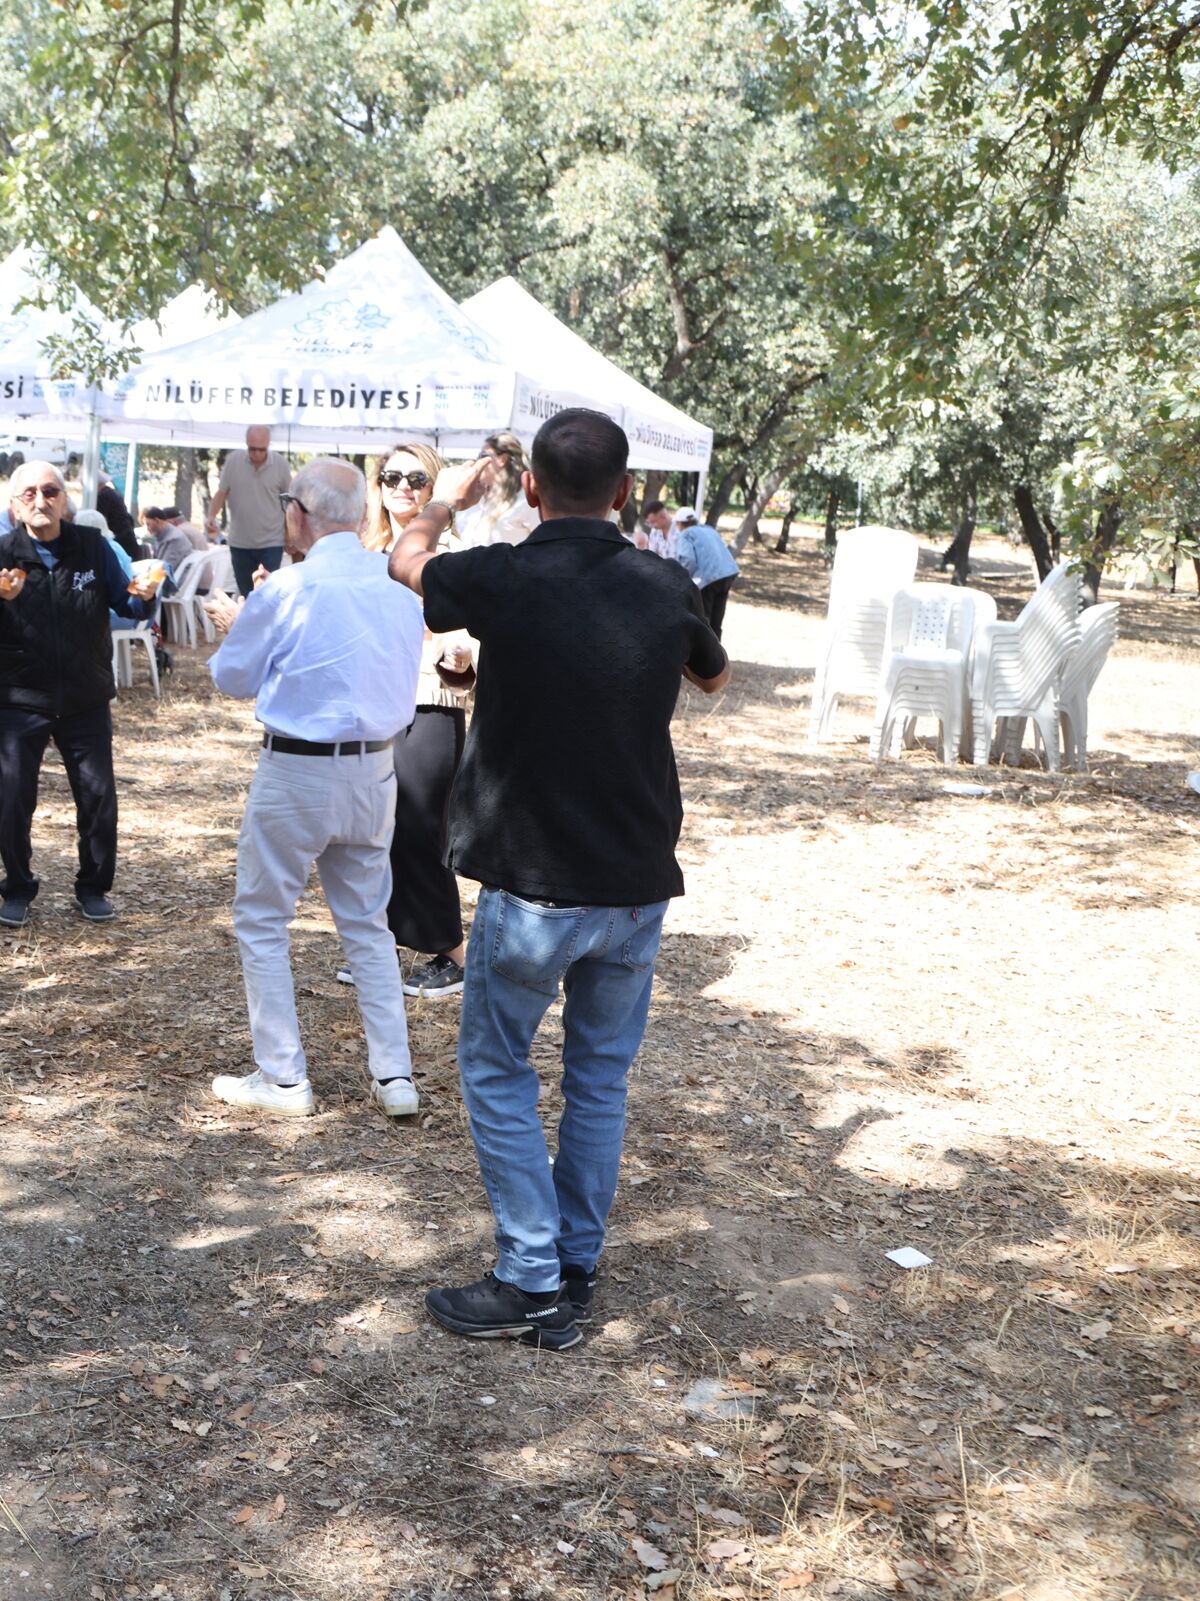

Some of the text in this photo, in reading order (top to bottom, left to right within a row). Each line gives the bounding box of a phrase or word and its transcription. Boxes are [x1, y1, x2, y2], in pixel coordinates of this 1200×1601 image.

[147, 379, 253, 405] NİLÜFER
[264, 383, 422, 410] BELEDİYESİ
[525, 1307, 558, 1318] SALOMON
